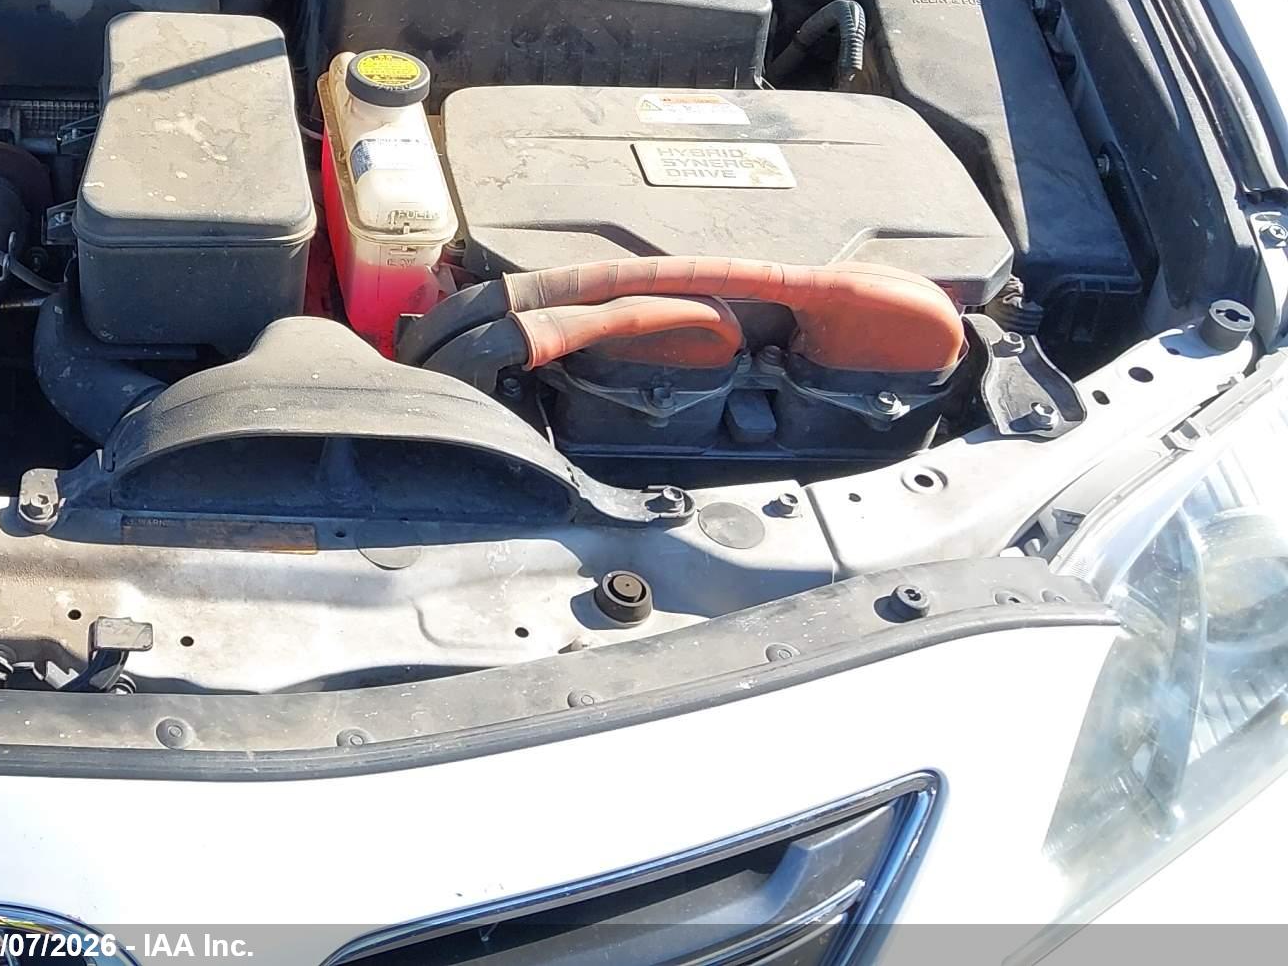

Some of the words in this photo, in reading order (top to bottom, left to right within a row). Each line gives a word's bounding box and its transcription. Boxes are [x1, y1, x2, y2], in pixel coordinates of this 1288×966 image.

[657, 147, 745, 158] HYBRID
[661, 157, 768, 170] SYNERGY
[666, 169, 737, 179] DRIVE
